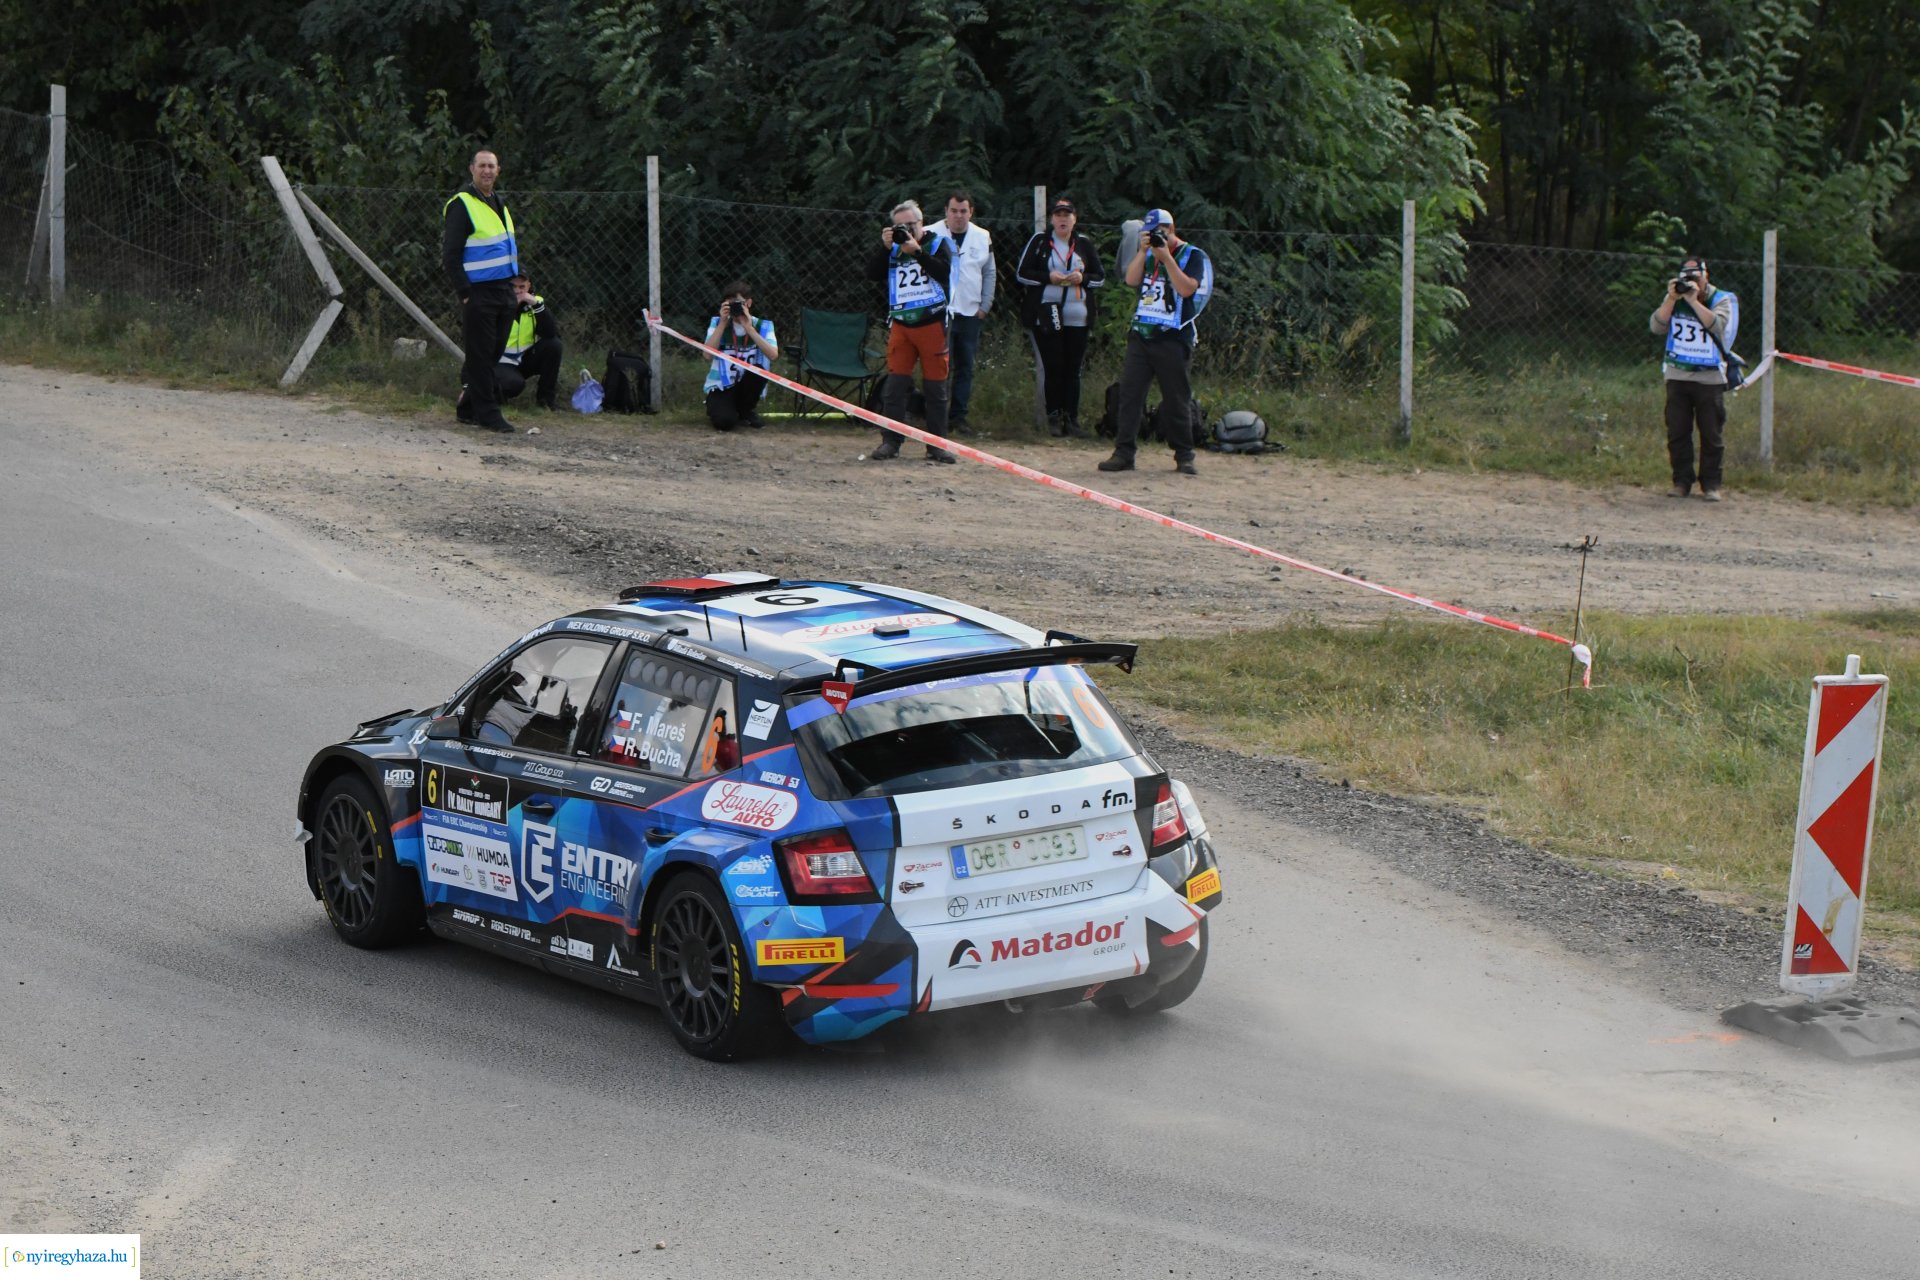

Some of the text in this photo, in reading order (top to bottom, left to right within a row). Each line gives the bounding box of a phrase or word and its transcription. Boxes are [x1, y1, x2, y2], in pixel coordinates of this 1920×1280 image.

[1051, 304, 1061, 331] adidas
[1673, 322, 1707, 343] 231
[754, 593, 819, 606] 6
[581, 622, 609, 634] HOLDING
[609, 626, 633, 637] GROUP
[826, 689, 848, 700] MOTUL
[630, 713, 686, 742] F. Mareš
[623, 736, 681, 768] R. Bucha
[701, 717, 723, 774] 6
[427, 769, 438, 804] 6
[456, 794, 474, 813] RALLY
[474, 801, 502, 820] HUNGARY
[732, 811, 775, 828] AUTO
[476, 847, 510, 869] HUMDA
[561, 841, 638, 891] ENTRY
[955, 866, 967, 875] CZ
[974, 879, 1094, 911] ATT INVESTMENTS
[1189, 872, 1218, 899] PIRELLI
[764, 941, 837, 960] PIRELLI
[990, 918, 1126, 964] Matador
[1092, 942, 1127, 956] GROUP
